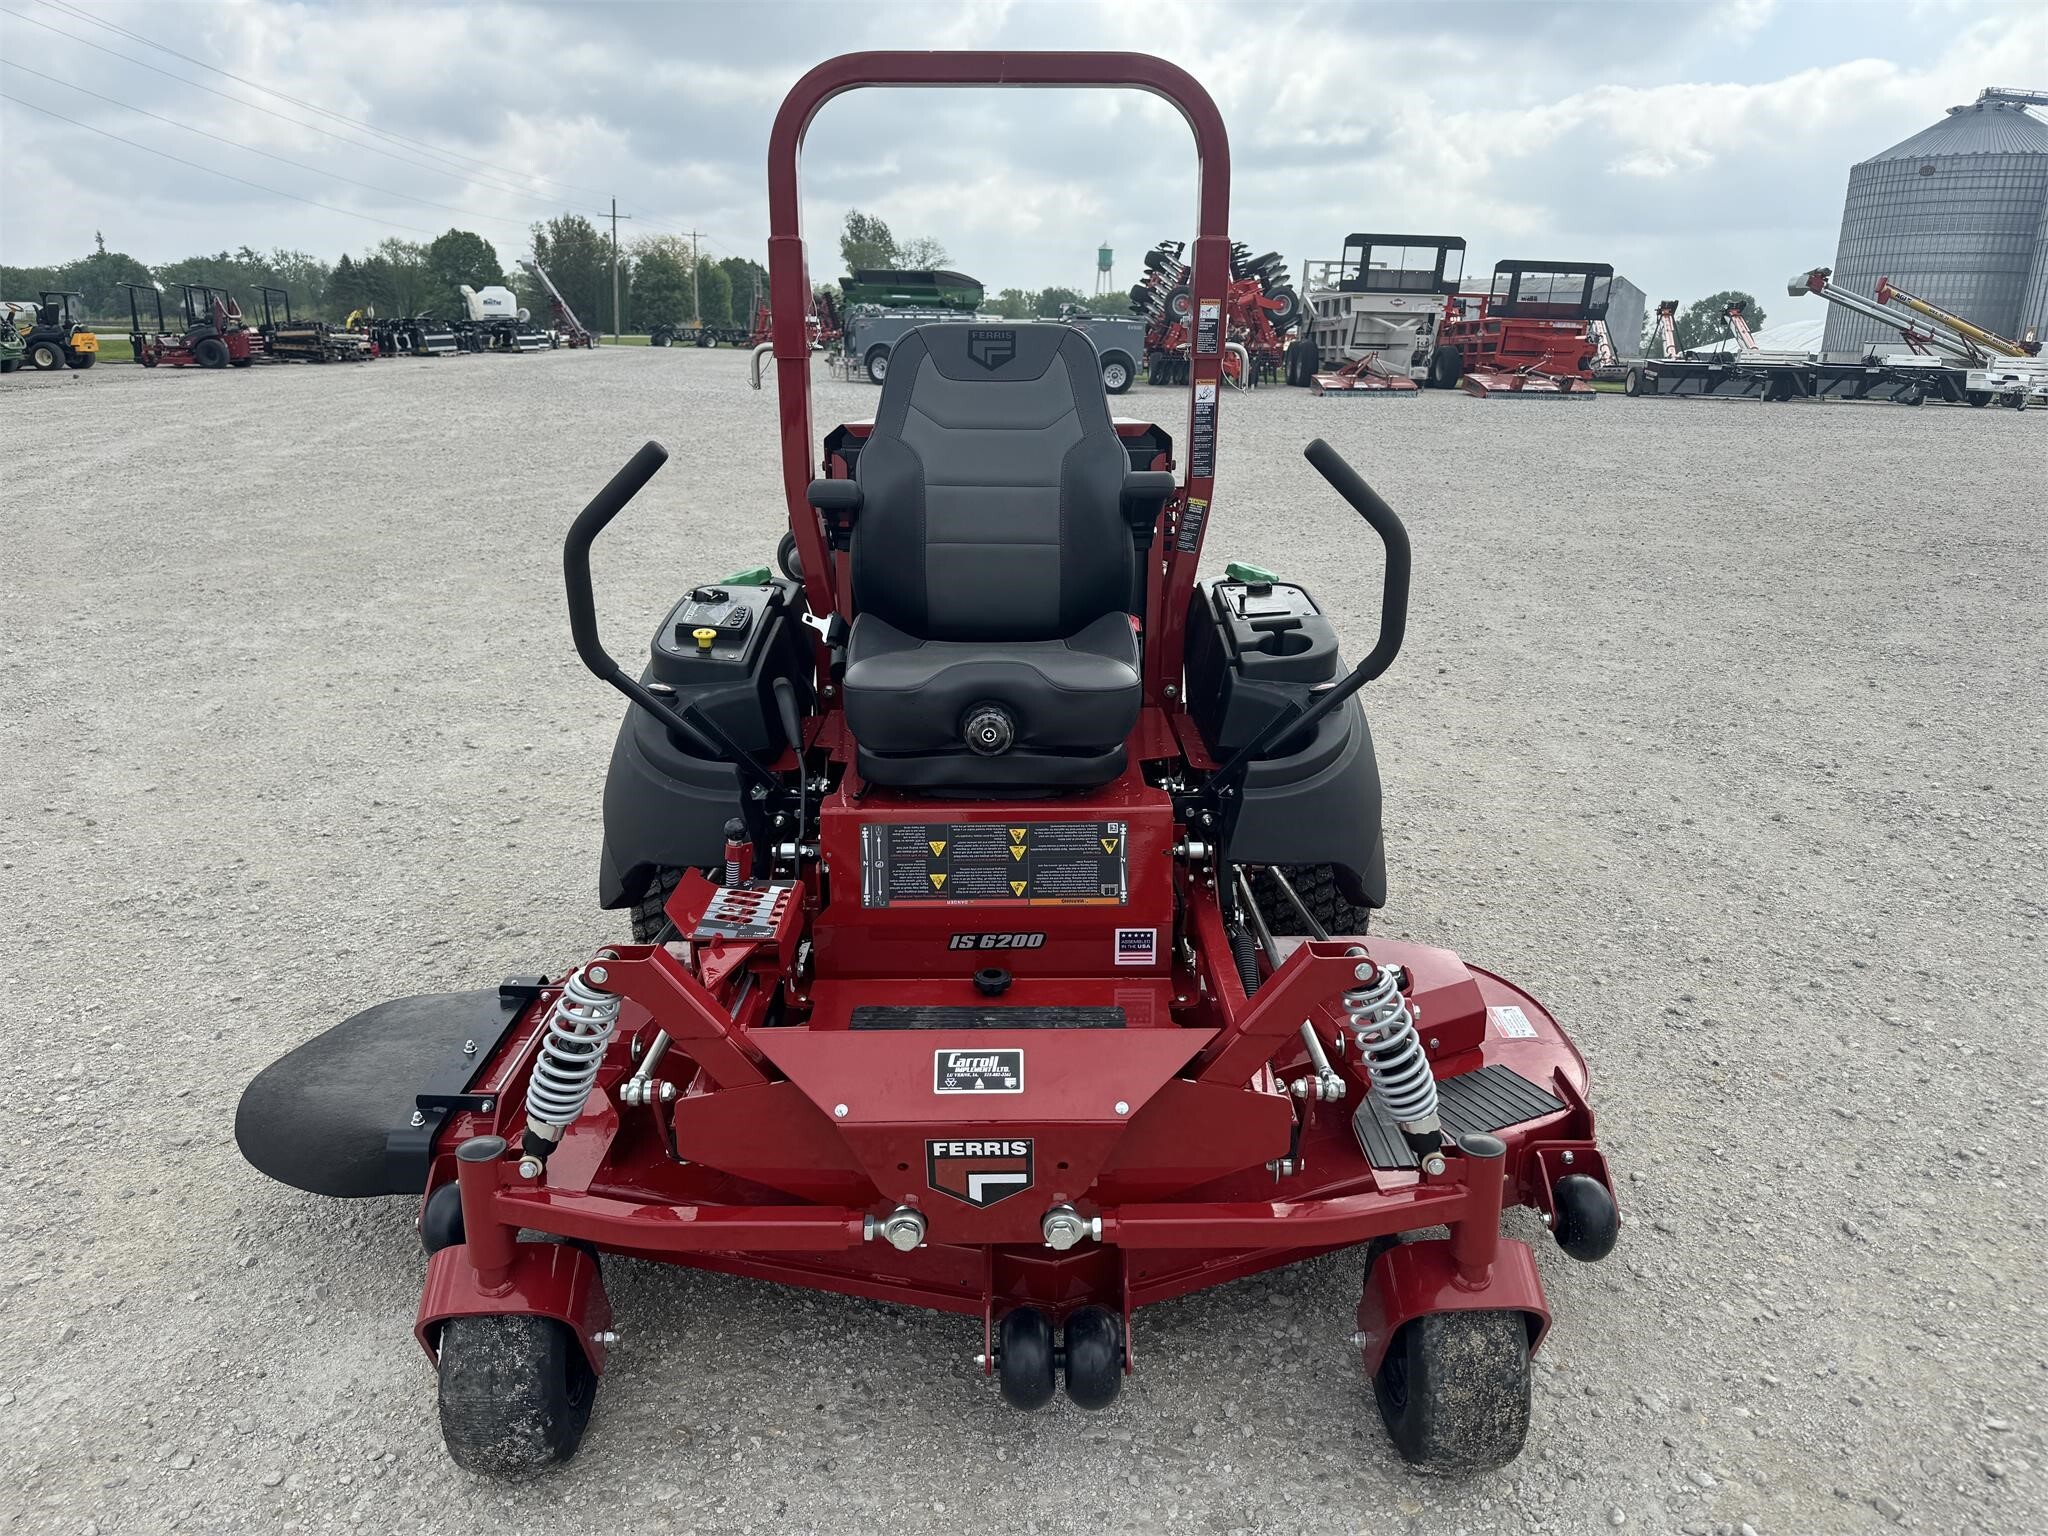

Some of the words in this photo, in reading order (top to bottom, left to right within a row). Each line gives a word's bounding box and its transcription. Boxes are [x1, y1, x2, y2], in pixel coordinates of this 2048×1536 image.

[973, 331, 1011, 339] FERRIS
[950, 935, 976, 949] IS
[980, 934, 1044, 949] 6200
[948, 1053, 999, 1072] Carroll
[933, 1141, 1027, 1156] FERRIS
